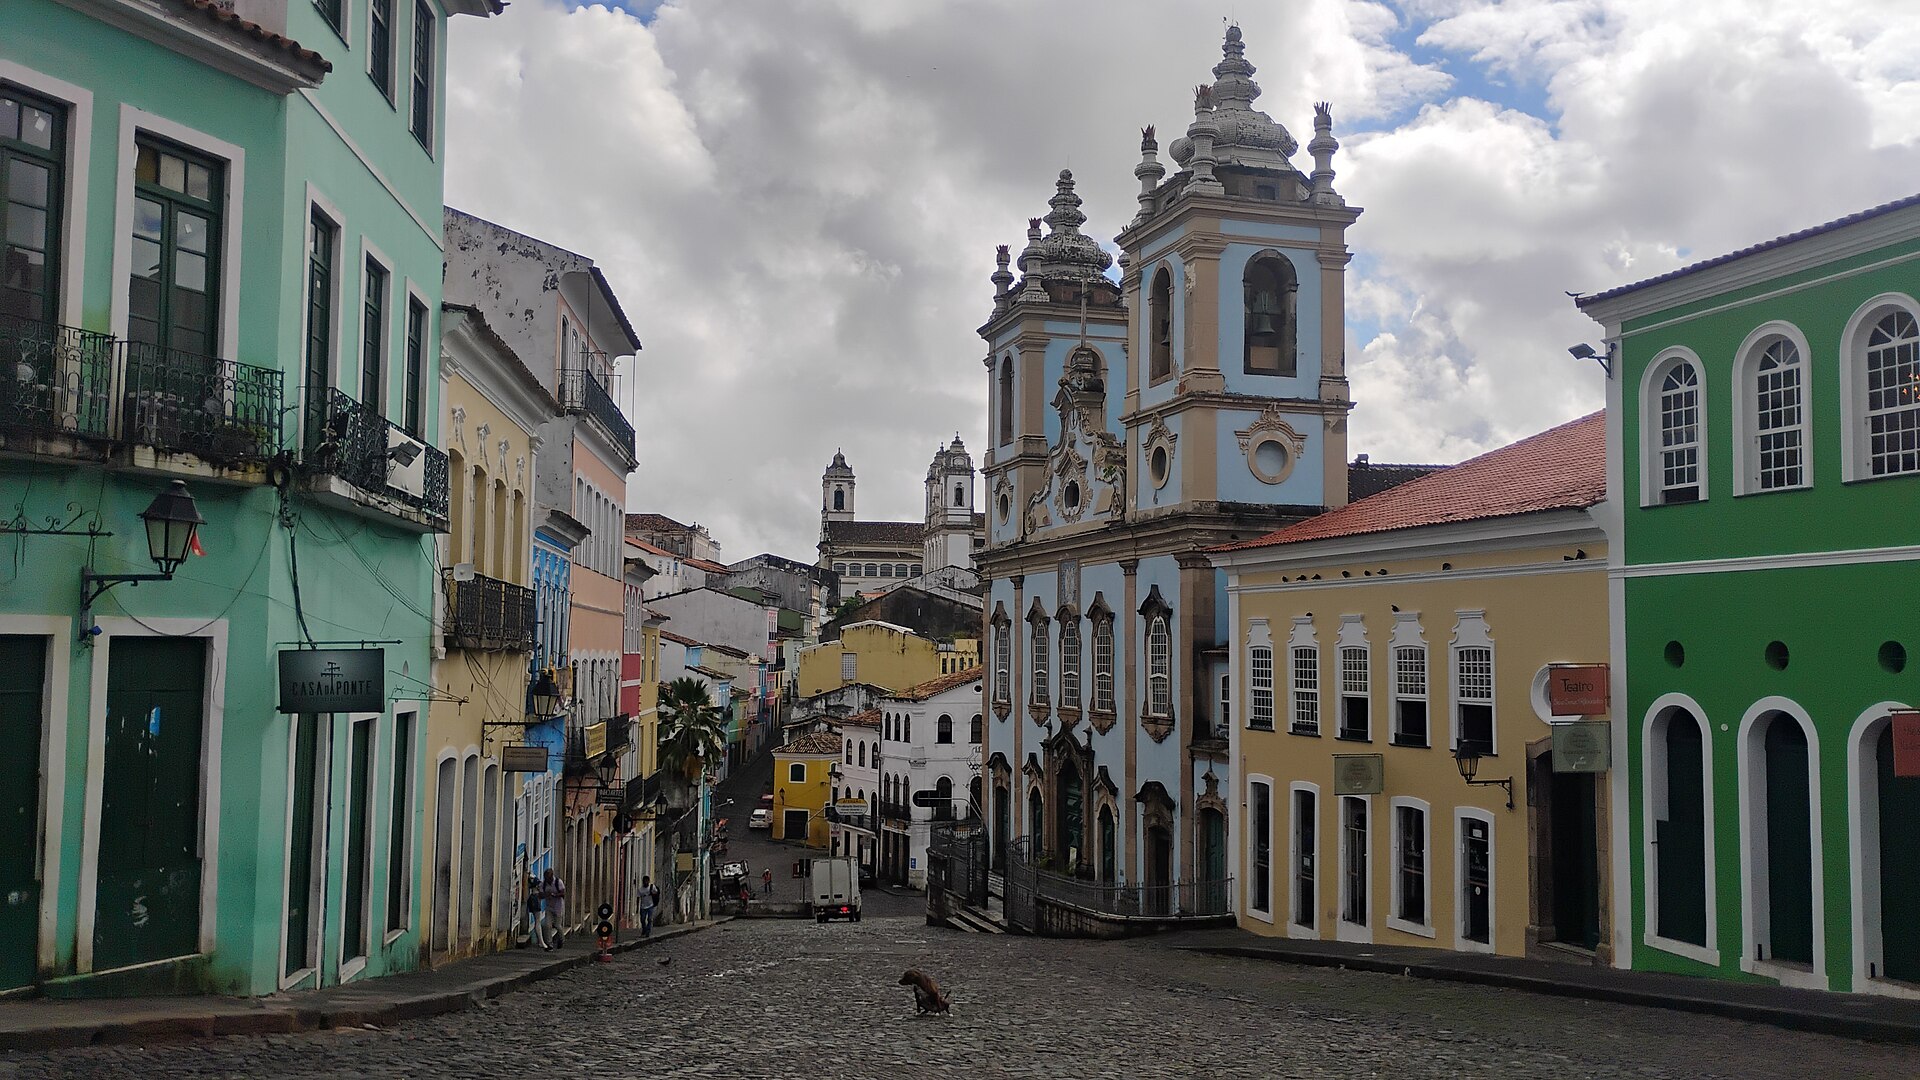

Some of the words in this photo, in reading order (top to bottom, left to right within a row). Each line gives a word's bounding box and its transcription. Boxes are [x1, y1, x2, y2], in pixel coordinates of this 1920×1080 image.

[292, 681, 323, 696] CASA
[336, 680, 372, 695] PONTE
[1561, 679, 1594, 692] Teatro
